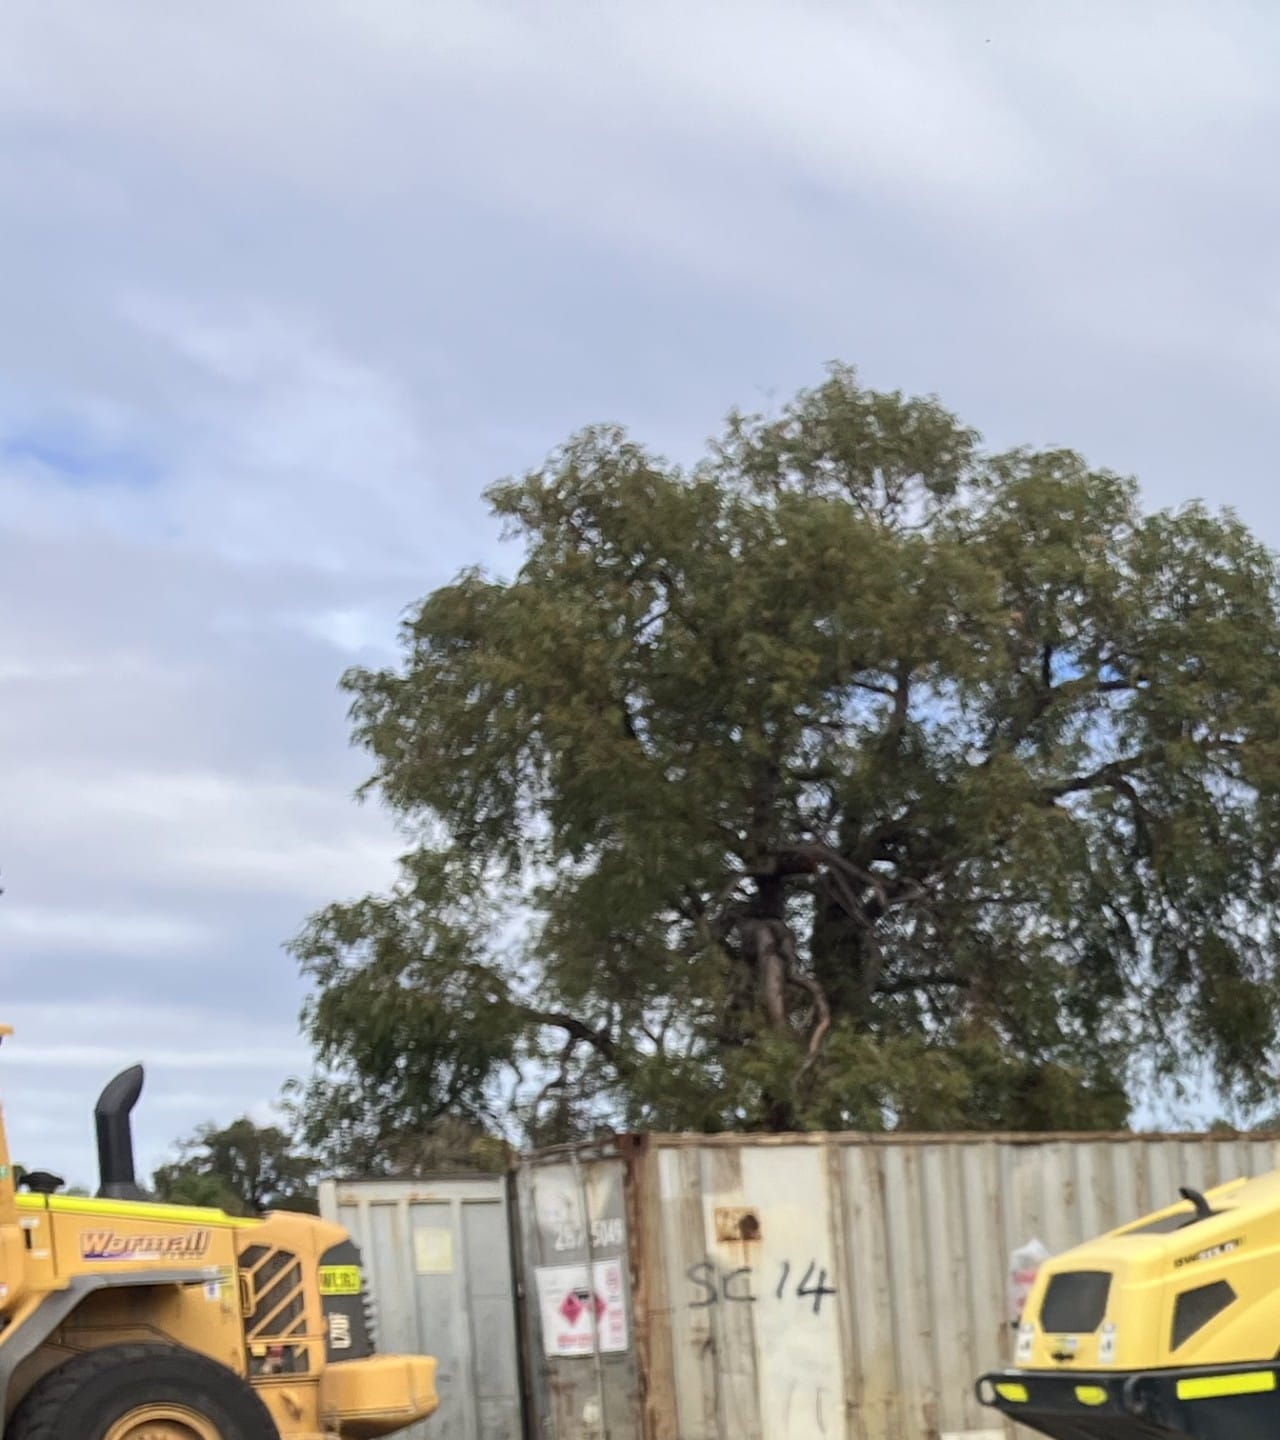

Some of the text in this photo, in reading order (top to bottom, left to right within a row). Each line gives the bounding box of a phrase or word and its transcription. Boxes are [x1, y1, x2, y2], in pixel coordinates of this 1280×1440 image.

[80, 1230, 211, 1254] Wormall
[687, 1260, 837, 1314] SC 14
